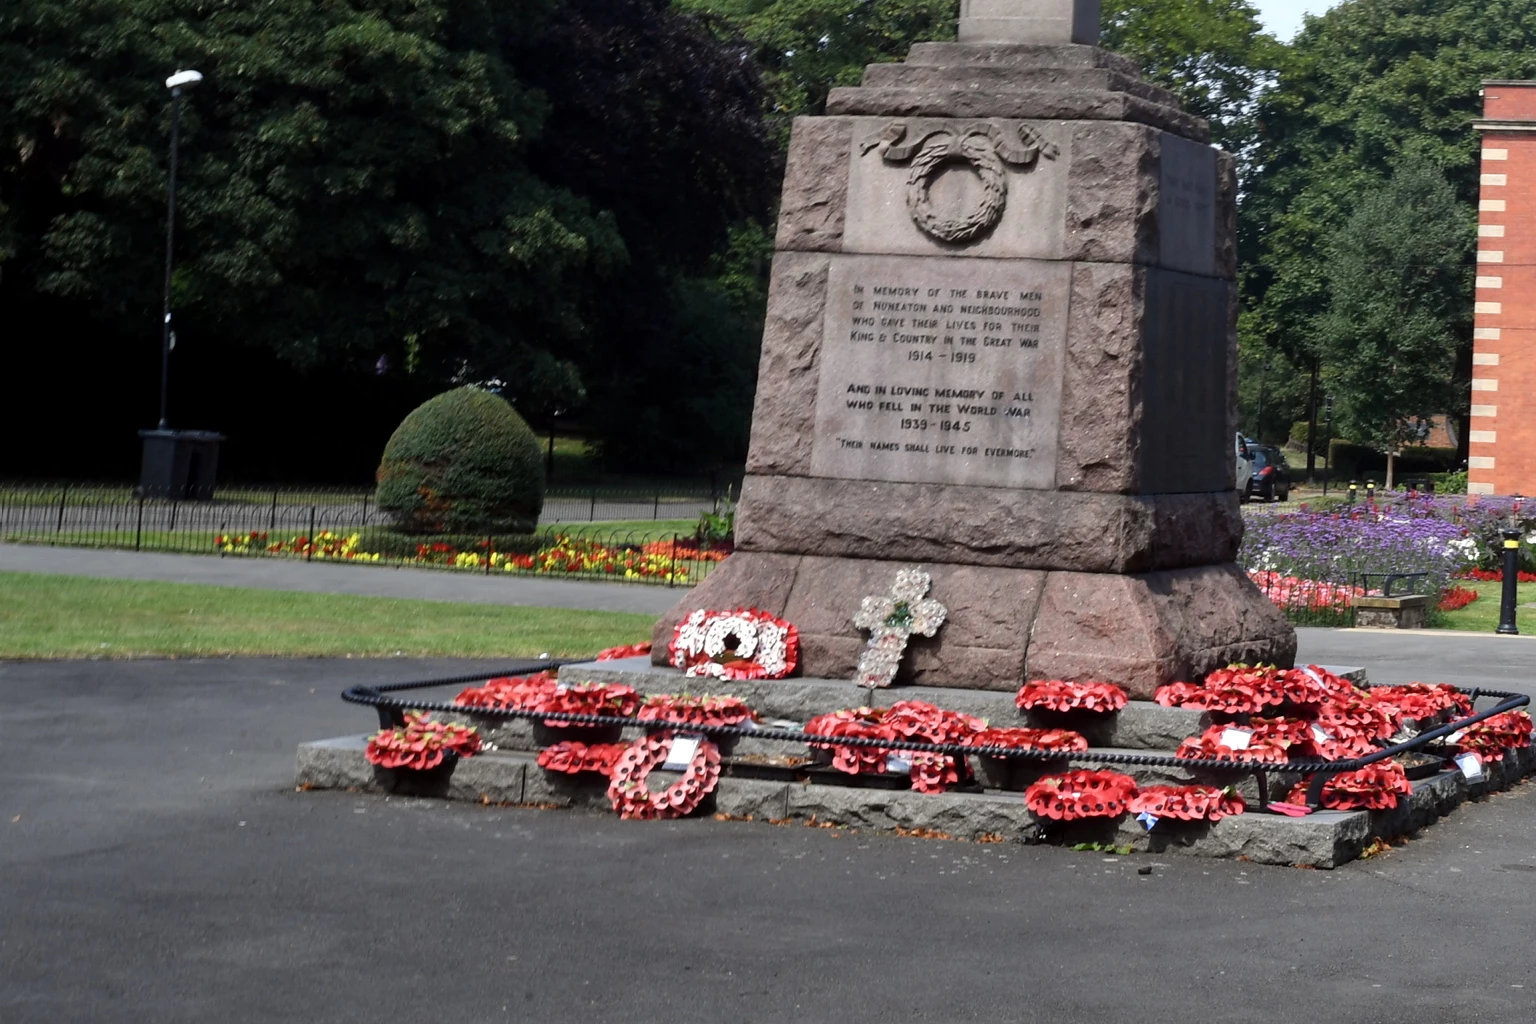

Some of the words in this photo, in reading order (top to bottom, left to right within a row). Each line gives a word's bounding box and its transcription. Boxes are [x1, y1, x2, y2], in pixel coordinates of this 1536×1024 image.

[853, 284, 864, 294] IN
[873, 286, 919, 296] MEMORY
[927, 288, 941, 297] OF
[950, 289, 968, 298] THE
[976, 290, 1009, 300] BRAVE
[1020, 291, 1042, 301] MEN
[852, 301, 864, 310] OF
[873, 301, 928, 313] NUNEATON
[932, 304, 954, 313] AND
[960, 305, 1041, 317] NEIGHBOURHOOD
[852, 317, 875, 326] WHO
[881, 318, 905, 328] GAVE
[912, 319, 938, 328] THEIR
[946, 321, 977, 330] LIVES
[983, 321, 1002, 331] FOR
[1011, 322, 1040, 333] THEIR
[850, 330, 874, 342] KING
[879, 333, 887, 342] &
[893, 332, 937, 344] COUNTRY
[943, 336, 954, 345] IN
[960, 337, 977, 346] THE
[983, 336, 1013, 347] GREAT
[1020, 338, 1039, 349] WAR
[908, 350, 933, 361] 1914
[951, 352, 976, 363] 1919
[847, 383, 871, 394] AND
[874, 386, 887, 395] IN
[890, 386, 929, 397] LOVING
[934, 388, 985, 399] MEMORY
[991, 391, 1005, 400] OF
[1013, 392, 1034, 402] ALL
[846, 400, 874, 410] WHO
[879, 401, 904, 412] FELL
[910, 403, 922, 412] IN
[929, 403, 951, 414] THE
[957, 404, 997, 416] WORLD
[1004, 406, 1031, 417] WAR
[900, 418, 928, 430] 1939
[940, 420, 971, 432] 1945
[870, 441, 900, 451] NAMES
[904, 443, 929, 453] SHALL
[935, 445, 955, 455] LIVE
[961, 446, 978, 455] FOR
